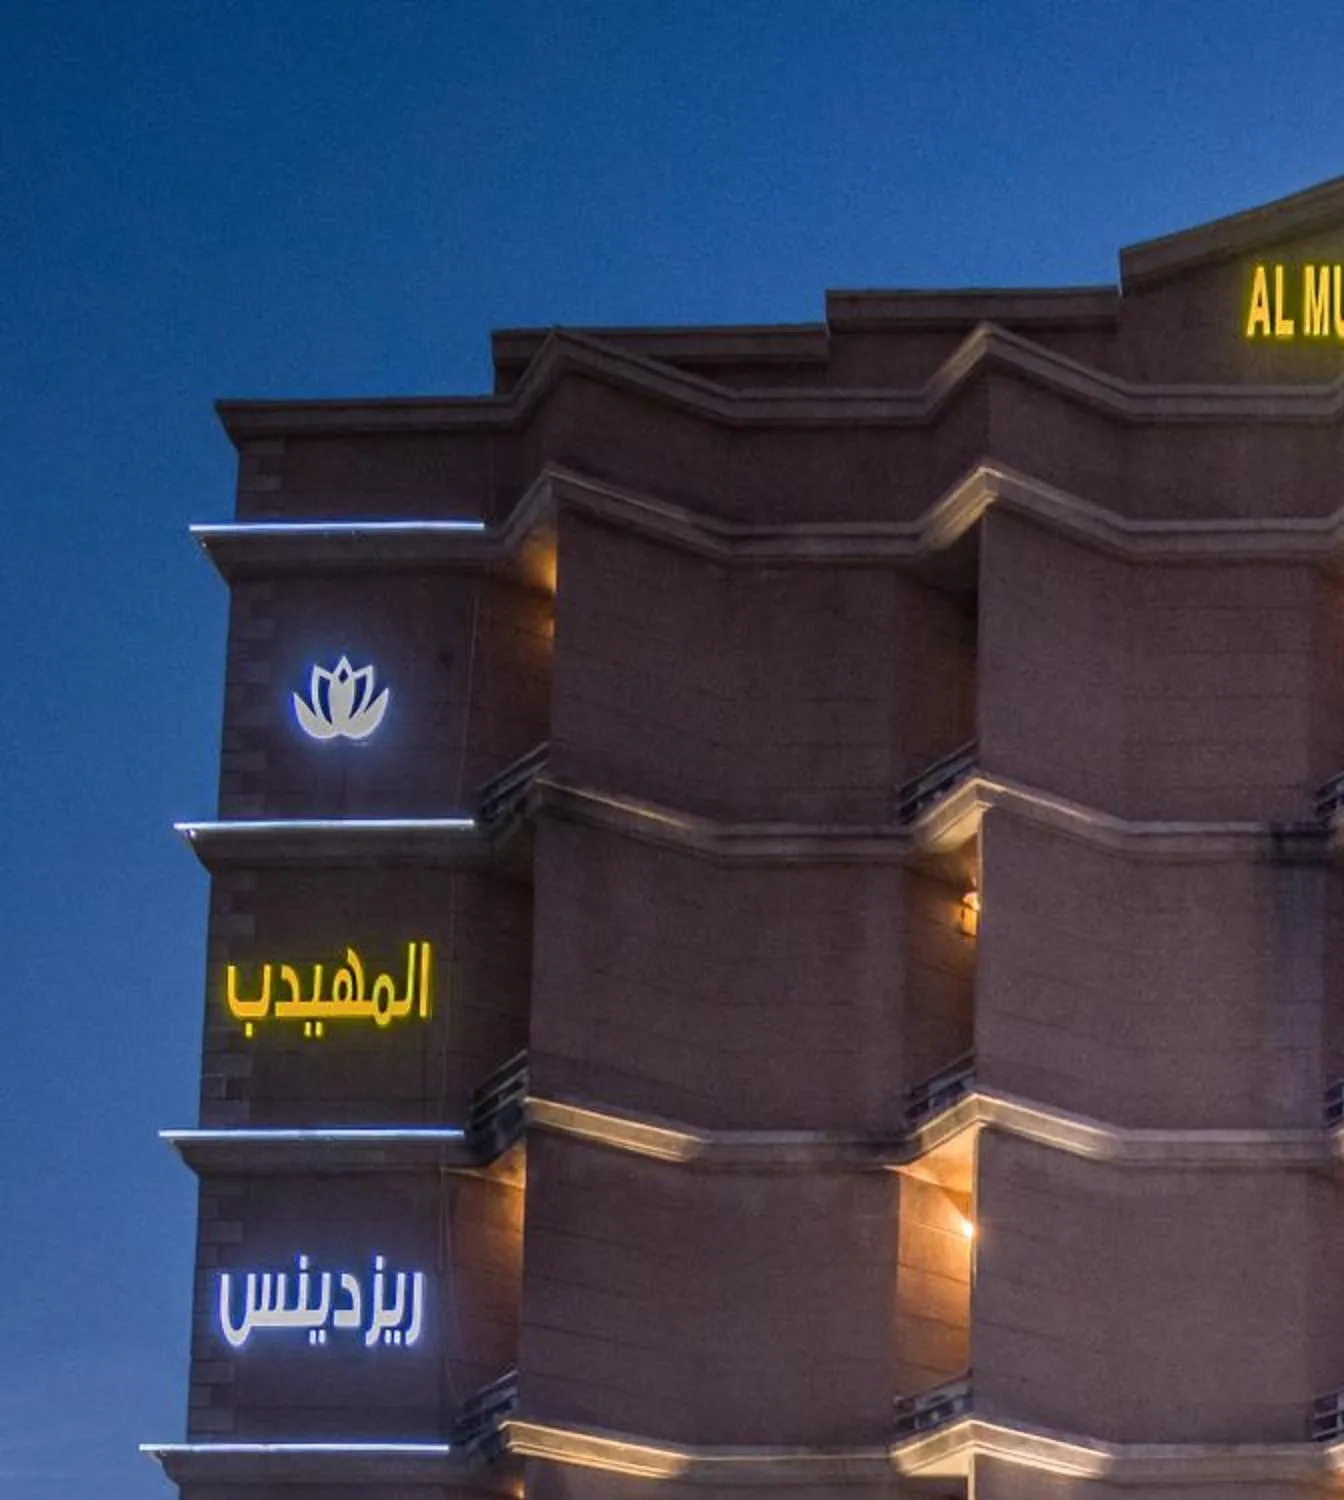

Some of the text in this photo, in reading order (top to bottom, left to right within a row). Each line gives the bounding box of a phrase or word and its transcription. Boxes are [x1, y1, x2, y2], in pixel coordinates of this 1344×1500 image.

[1246, 265, 1294, 337] AL
[227, 942, 430, 1038] المهيدب
[220, 1255, 424, 1346] ريزدينس
